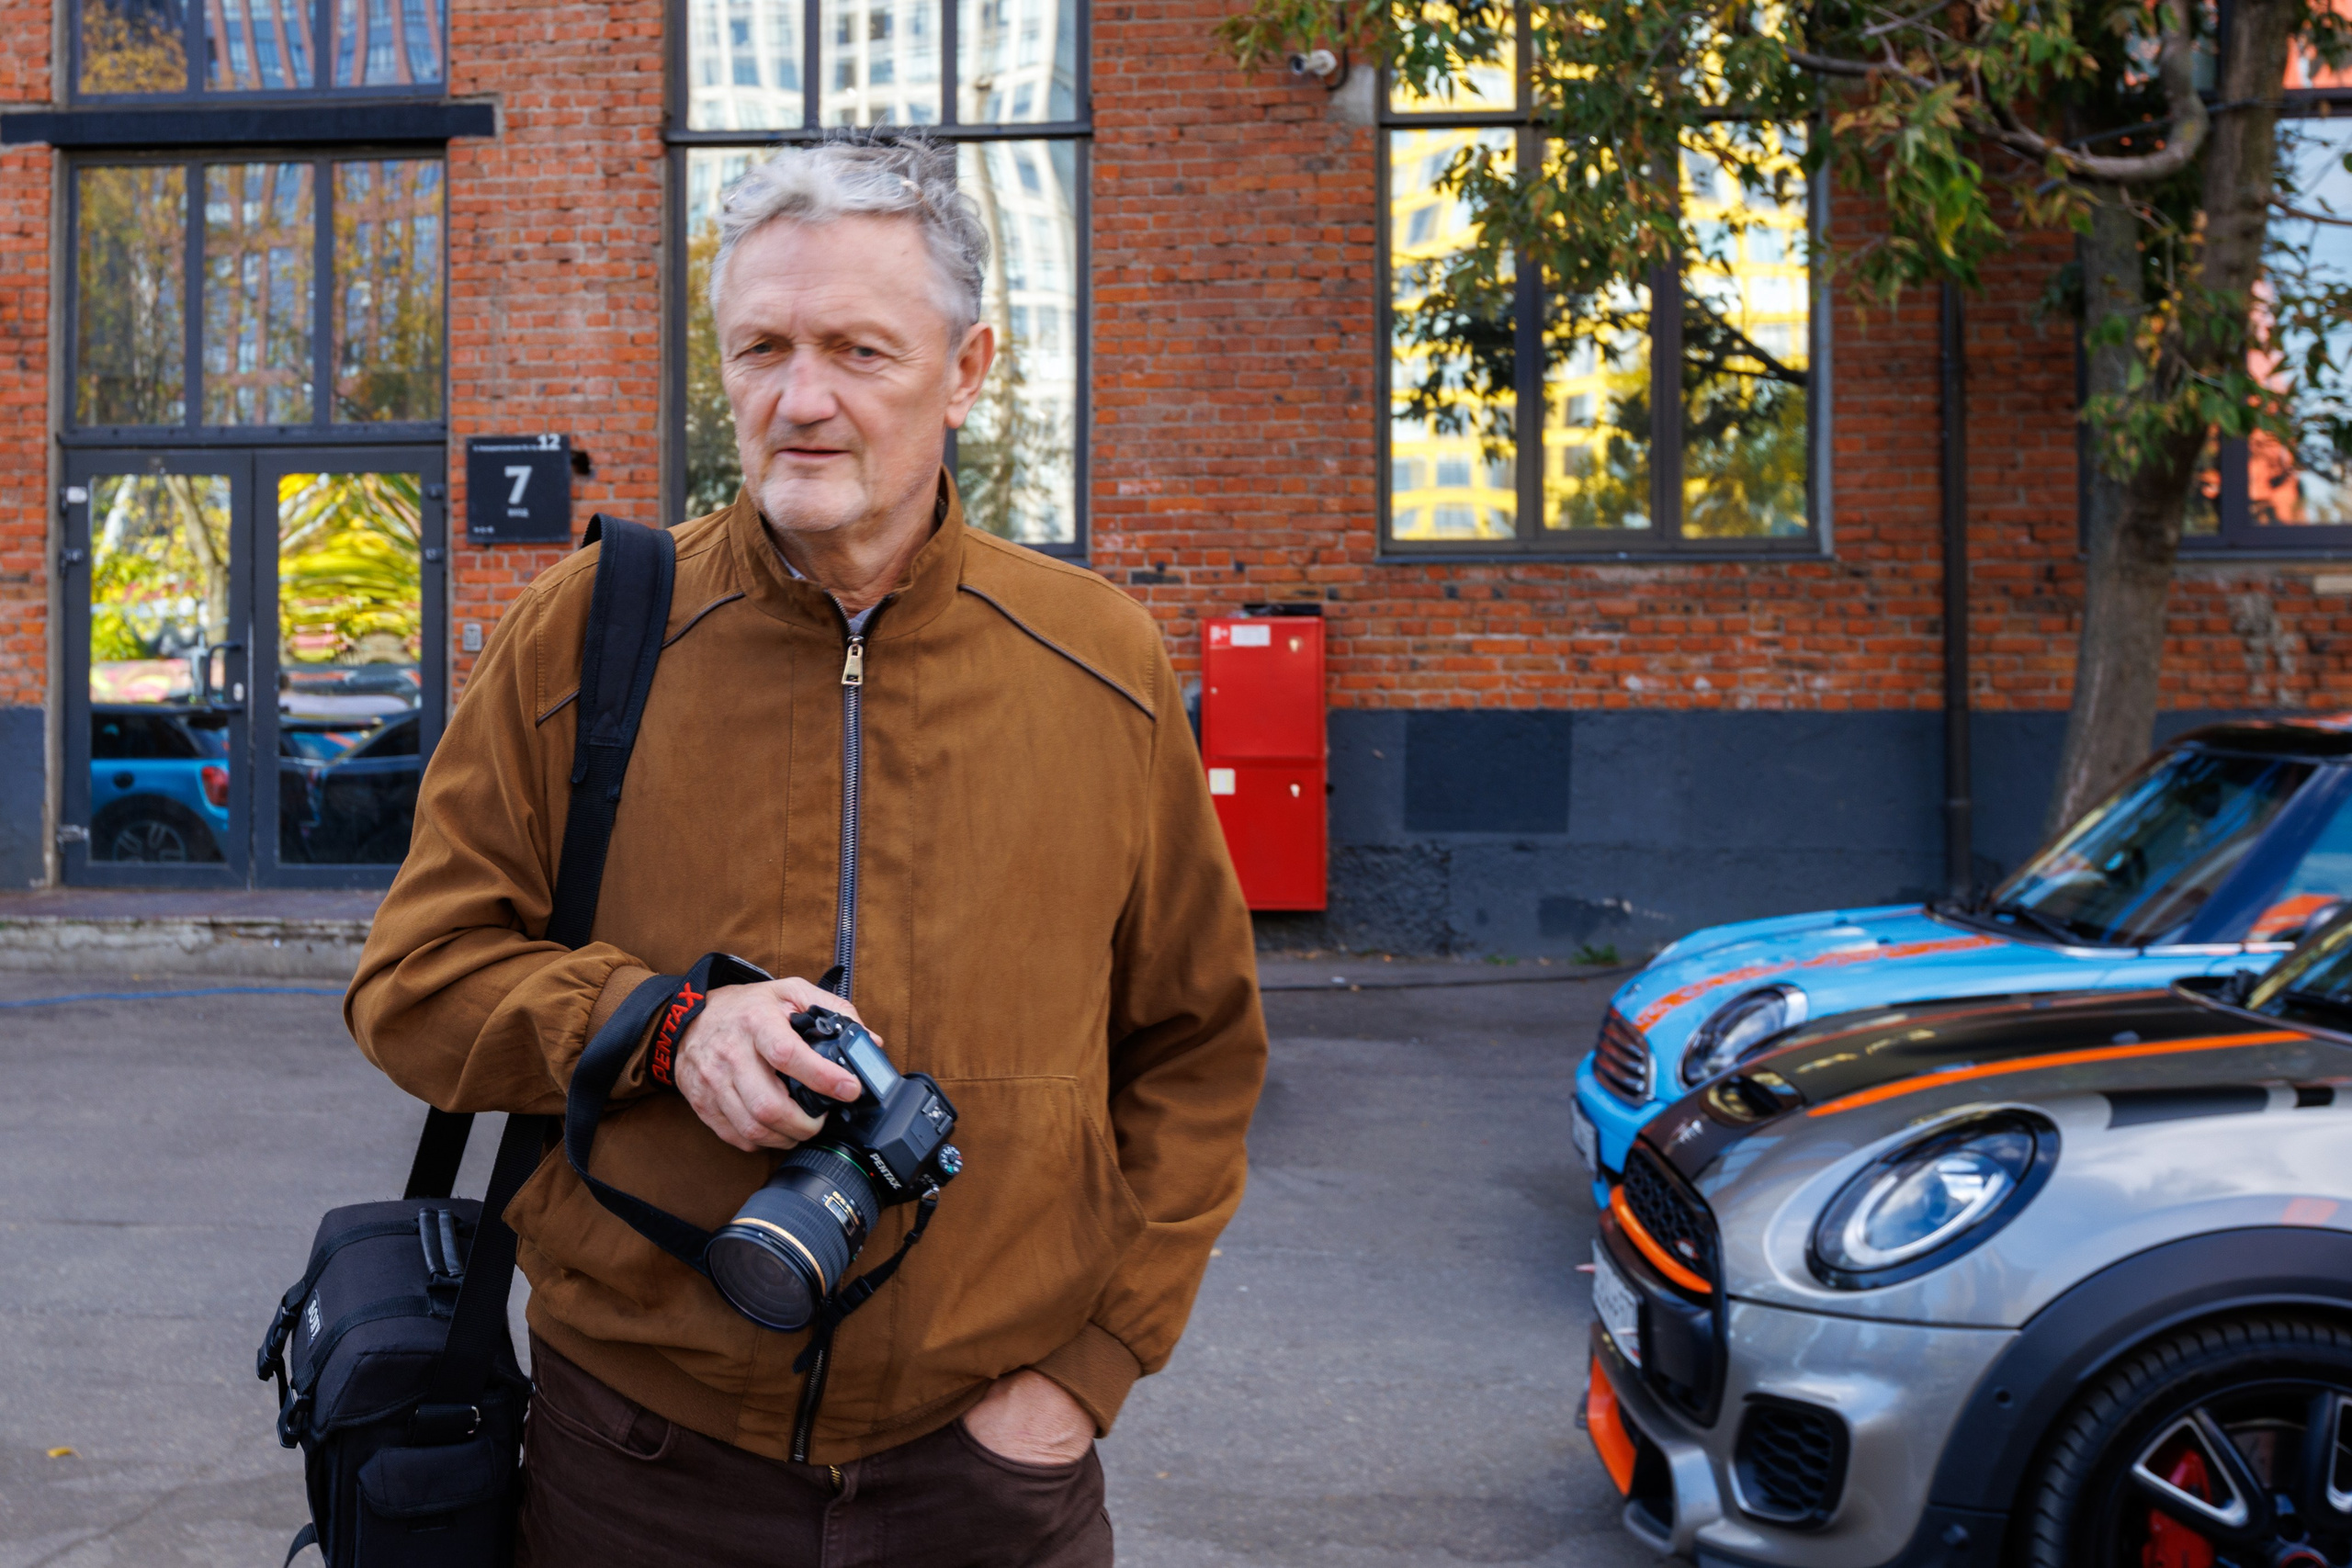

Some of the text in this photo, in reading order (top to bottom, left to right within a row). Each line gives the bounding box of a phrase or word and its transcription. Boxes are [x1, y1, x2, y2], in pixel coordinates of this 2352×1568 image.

[537, 434, 560, 451] 12
[504, 465, 533, 504] 7
[651, 981, 705, 1086] PENTAX
[869, 1152, 902, 1190] PENTAX
[308, 1299, 321, 1337] SONY
